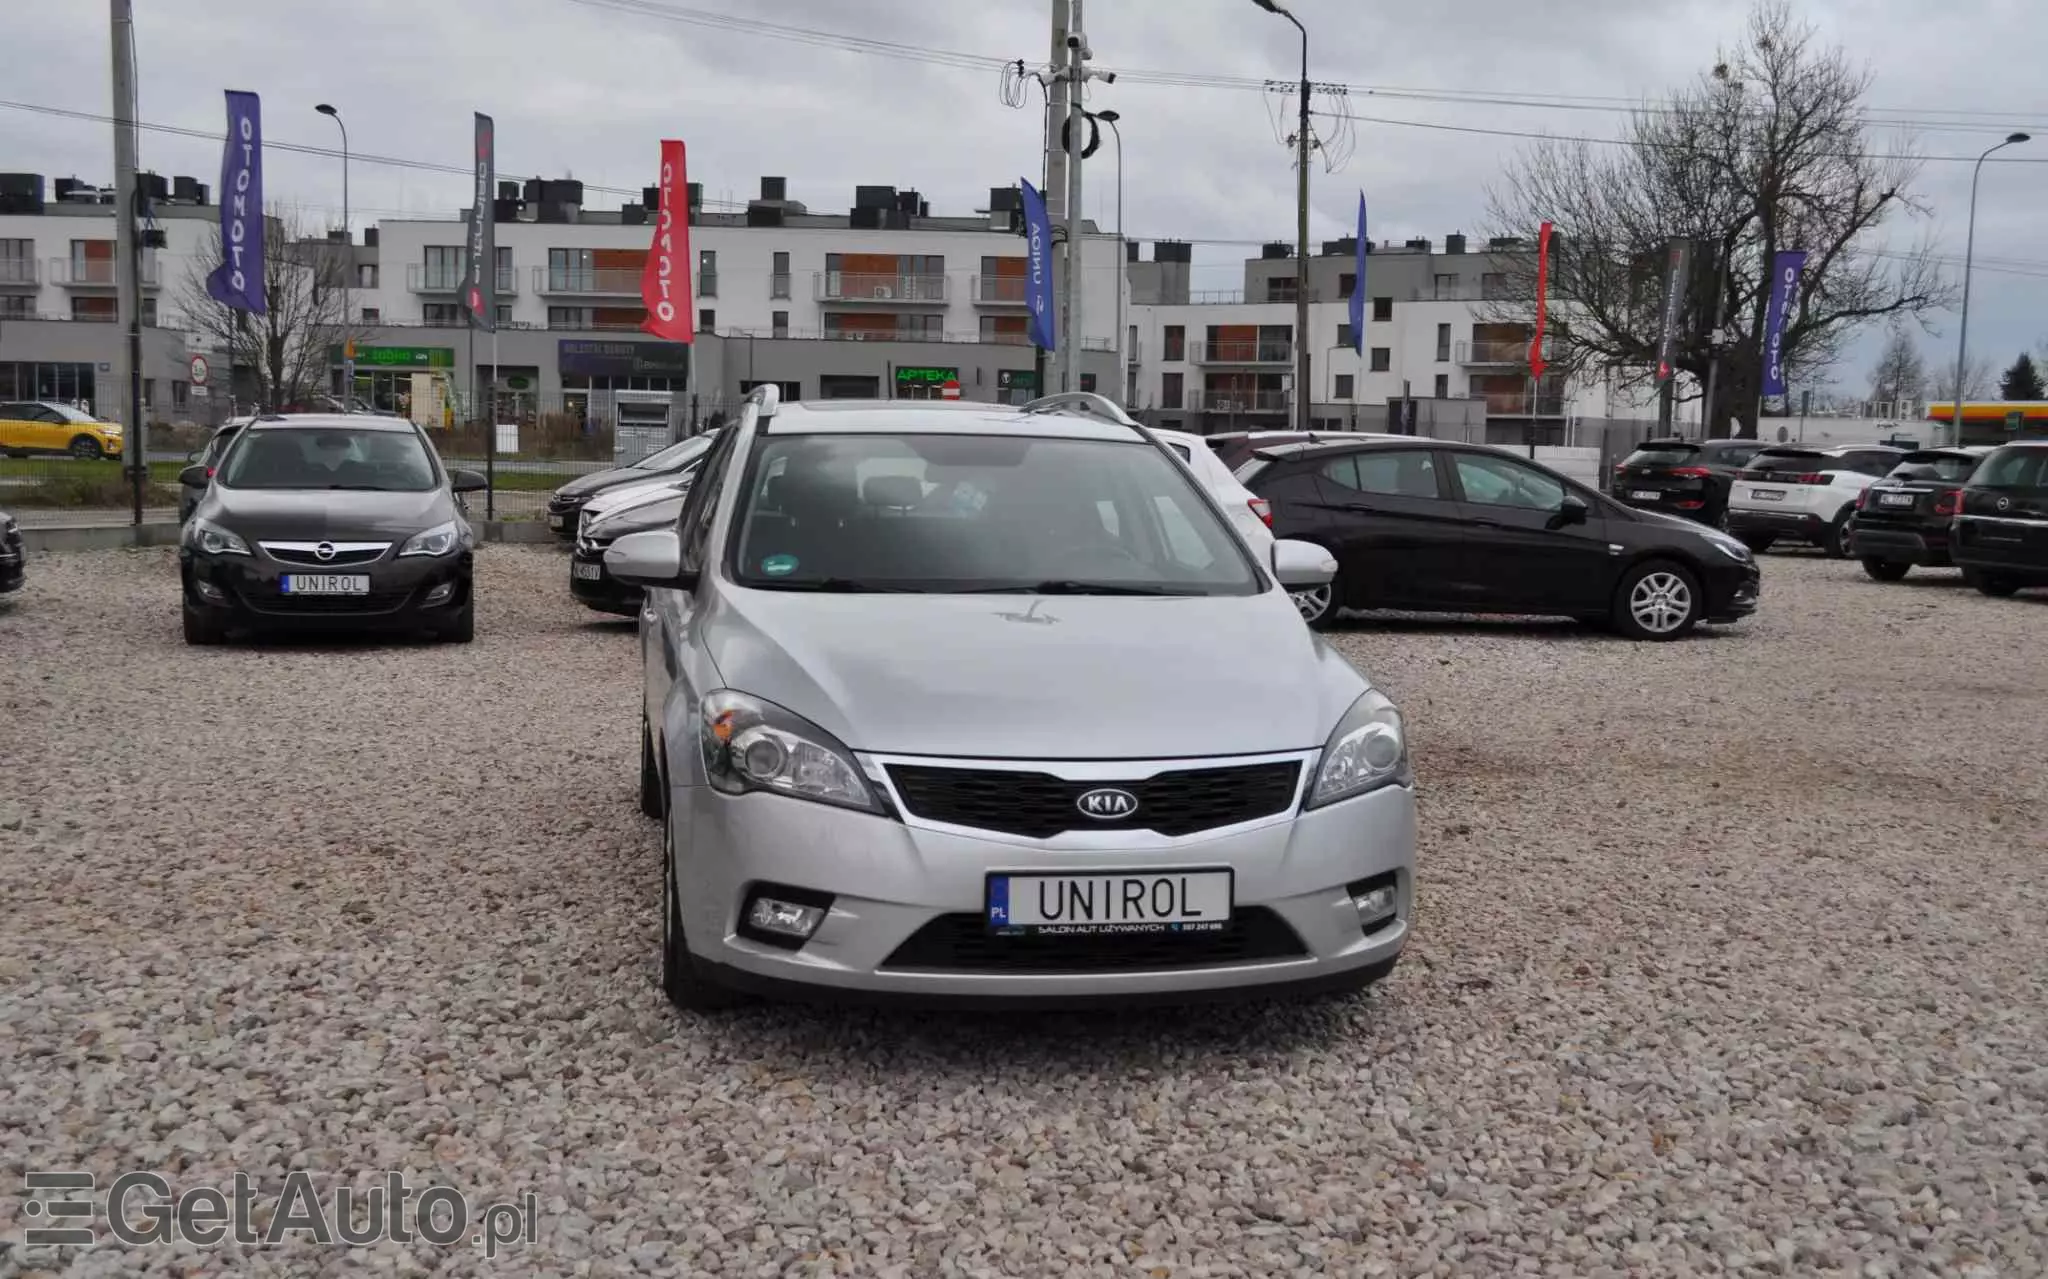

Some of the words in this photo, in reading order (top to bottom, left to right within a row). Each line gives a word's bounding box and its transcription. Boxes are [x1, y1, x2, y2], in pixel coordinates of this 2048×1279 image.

[231, 116, 252, 291] OTOMOTO
[1770, 267, 1795, 380] OTOOTO
[897, 369, 956, 380] APTEKA
[296, 575, 362, 591] UNIROL
[1087, 795, 1129, 811] KIA
[1039, 877, 1202, 920] UNIROL
[991, 907, 1007, 919] PL
[1038, 925, 1075, 934] SALON
[1076, 925, 1098, 933] AUT
